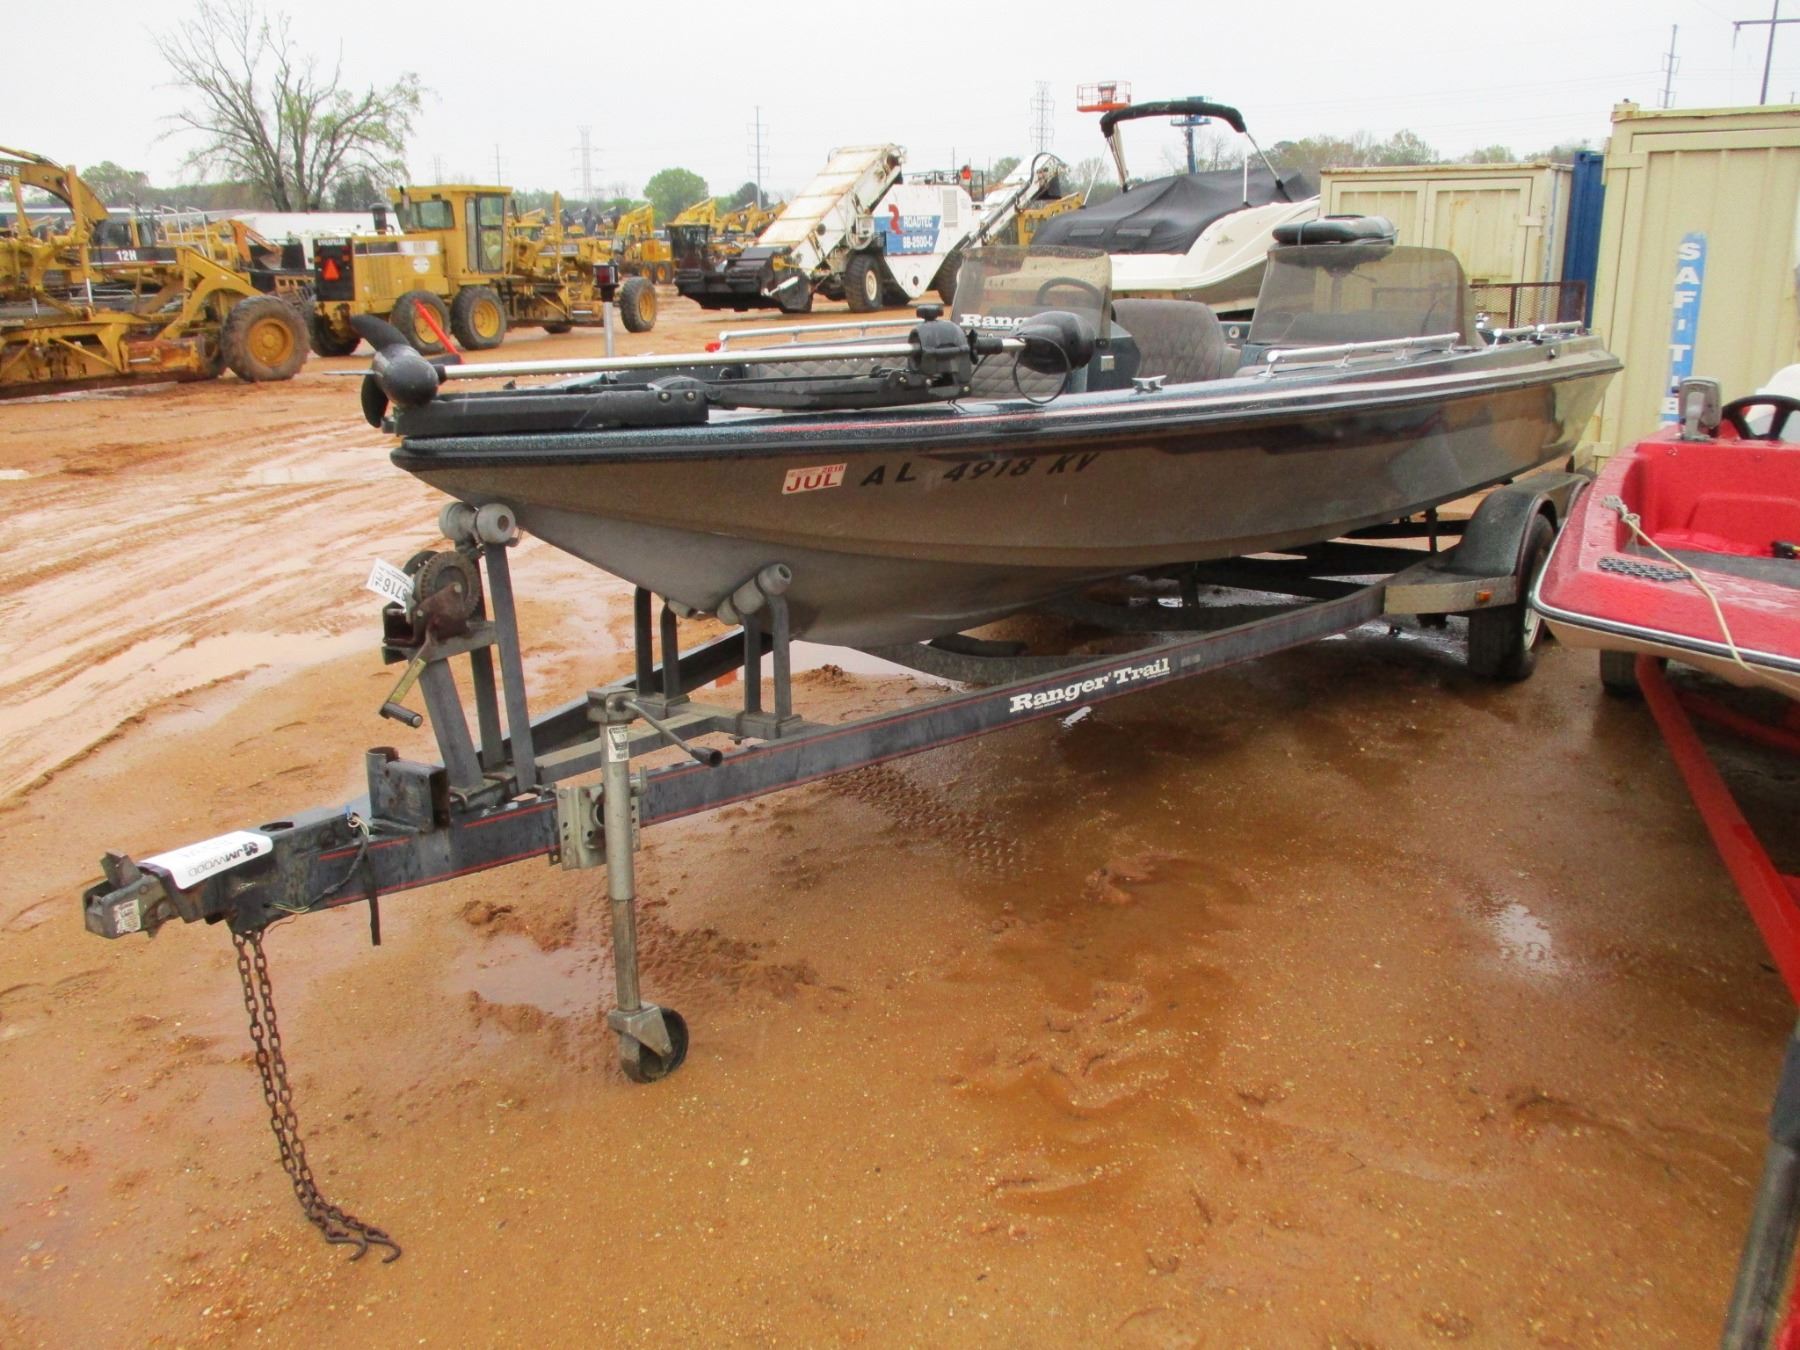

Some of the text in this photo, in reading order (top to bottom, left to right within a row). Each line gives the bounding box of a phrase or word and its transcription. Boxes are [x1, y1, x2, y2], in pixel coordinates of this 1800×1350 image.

[903, 215, 933, 229] ROADTEC
[960, 313, 1026, 331] Rang
[860, 453, 1099, 487] AL 4918 KV
[786, 473, 838, 492] JUL
[1009, 657, 1170, 713] Ranger Trail
